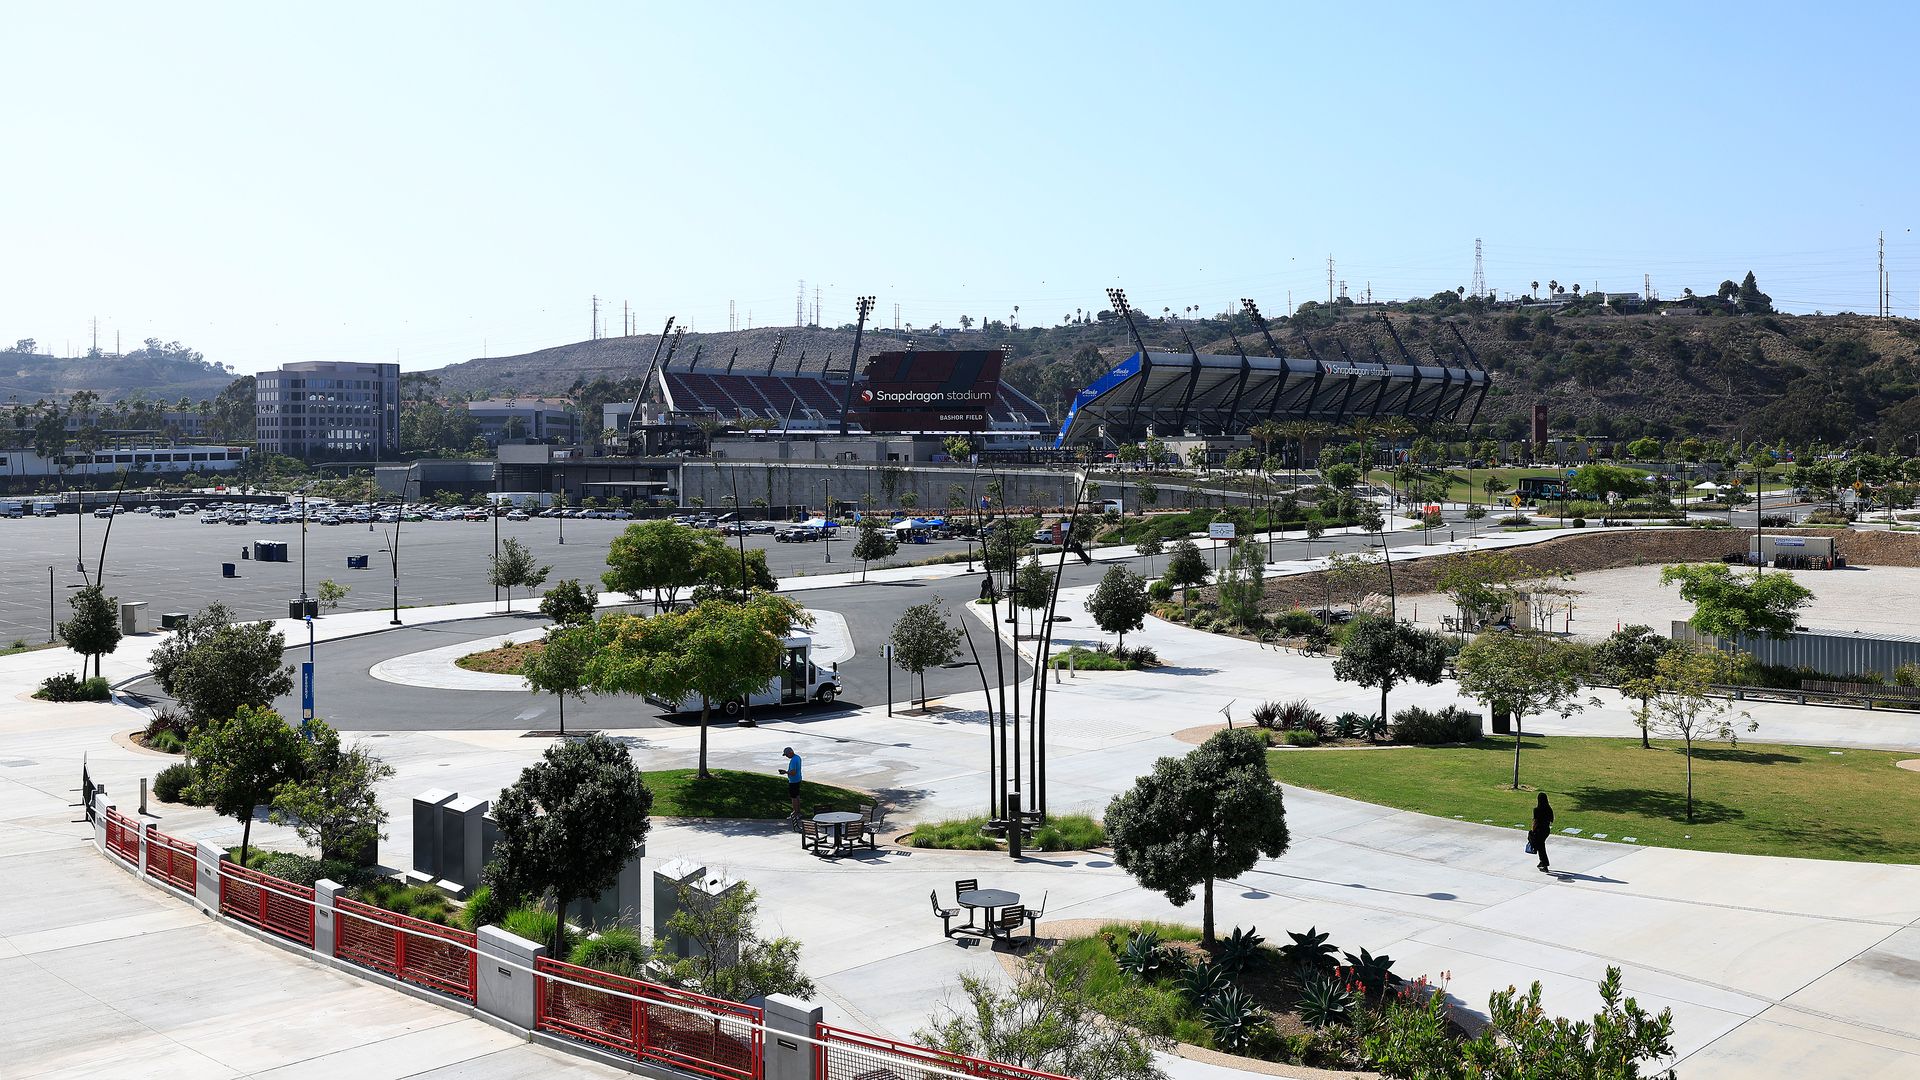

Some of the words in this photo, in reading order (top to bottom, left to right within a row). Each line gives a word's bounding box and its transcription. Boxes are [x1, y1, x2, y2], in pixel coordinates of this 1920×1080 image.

[1332, 364, 1369, 377] Snapdragon
[1370, 367, 1393, 377] stadium
[877, 390, 944, 403] Snapdragon
[946, 390, 992, 400] stadium
